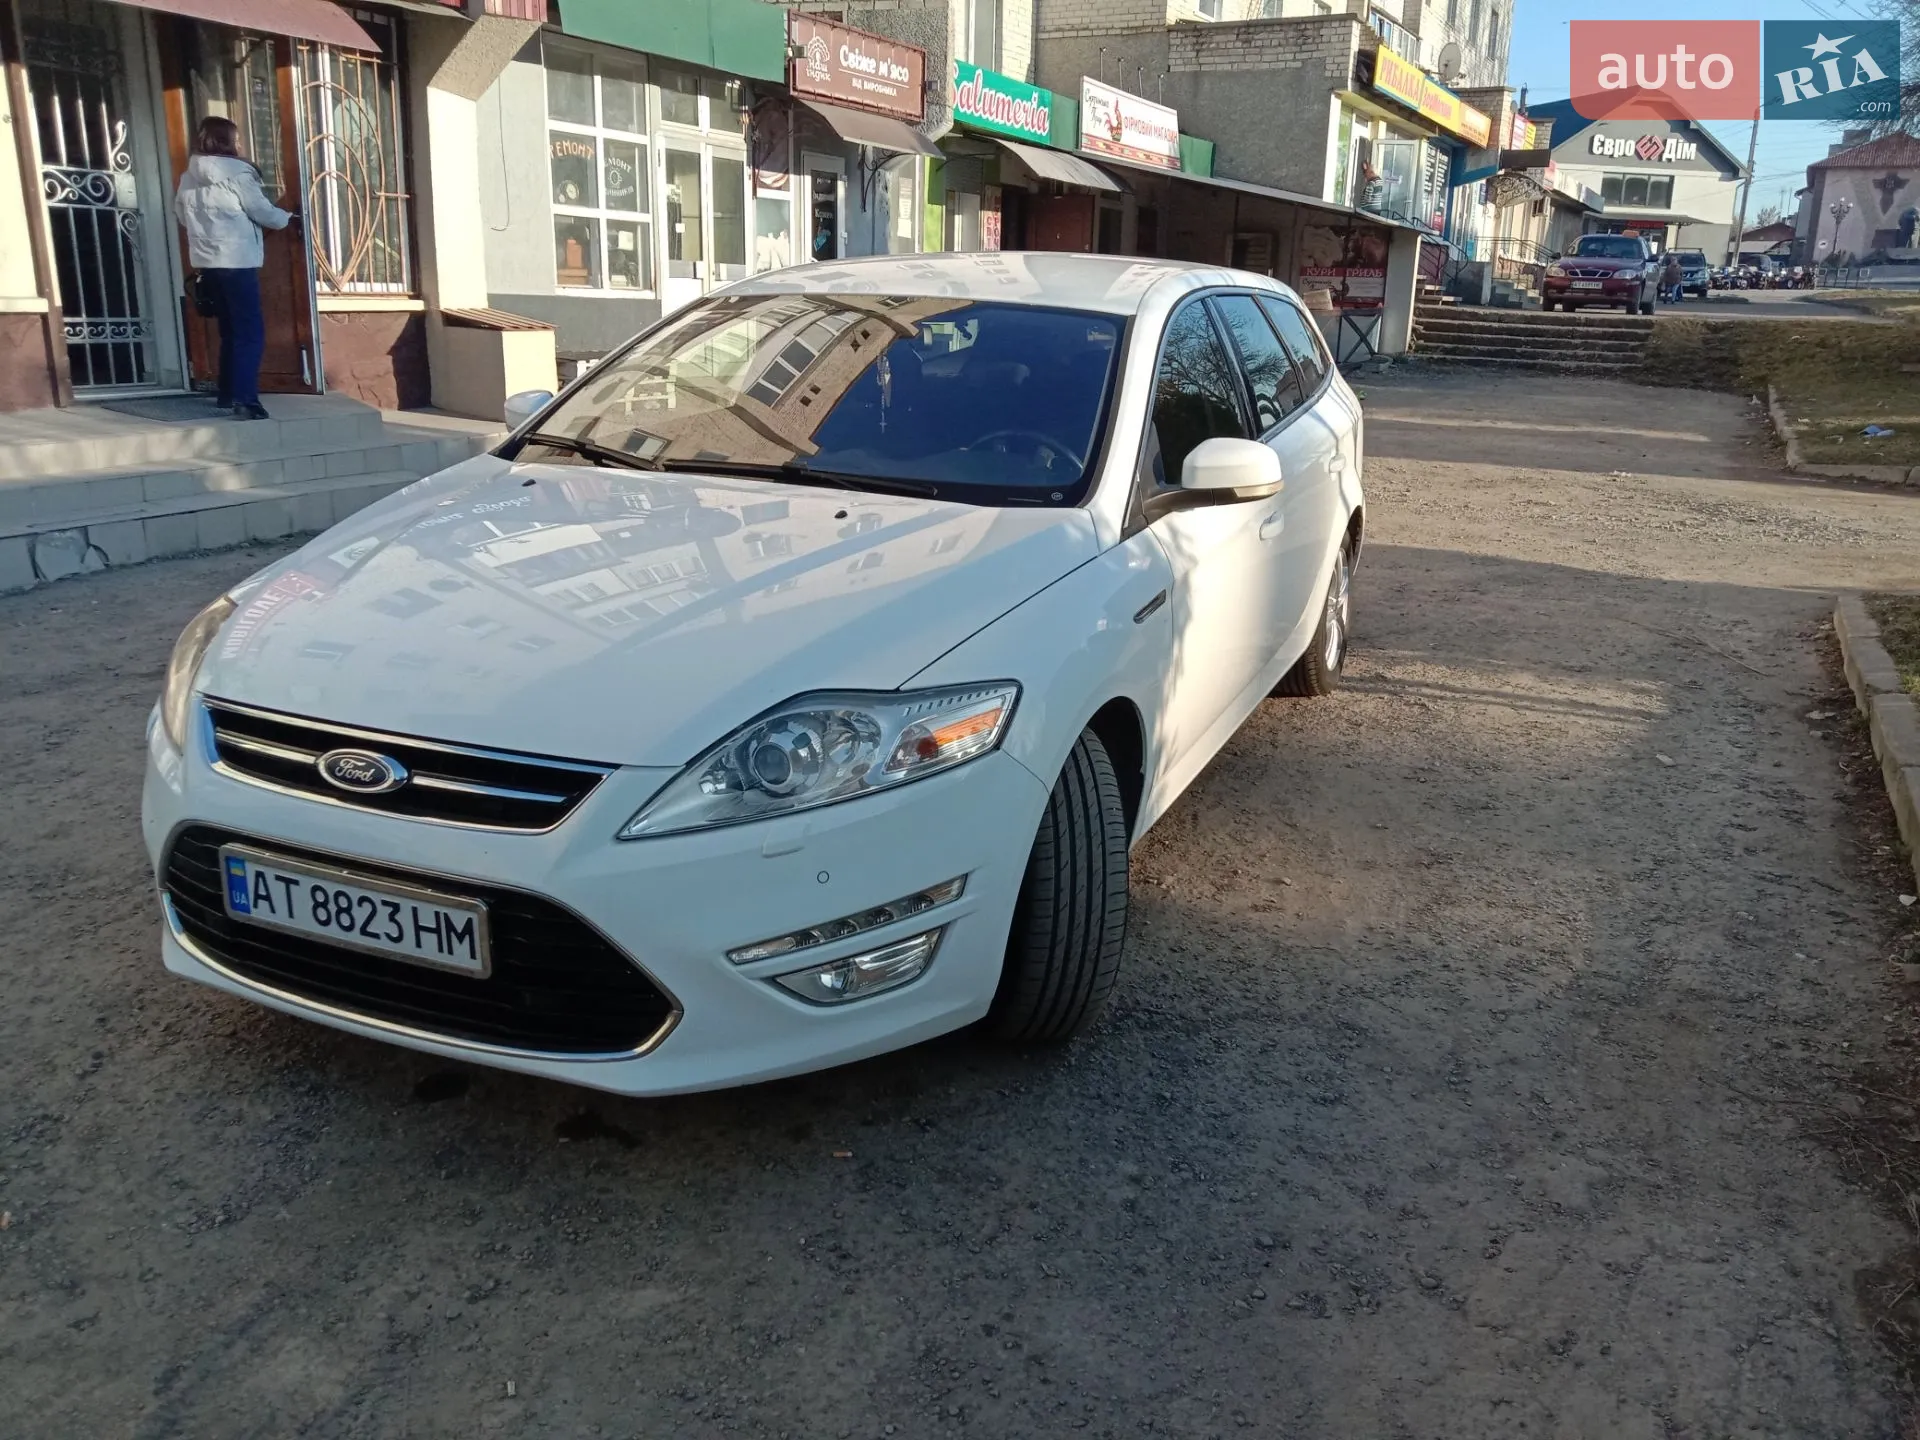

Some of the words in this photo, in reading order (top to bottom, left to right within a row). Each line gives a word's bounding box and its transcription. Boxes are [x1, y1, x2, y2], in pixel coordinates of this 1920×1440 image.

[839, 45, 877, 74] Свіже
[878, 57, 909, 83] м'ясо
[1592, 134, 1636, 158] Євро
[1662, 137, 1697, 162] Дім
[1306, 267, 1336, 276] КУРИ
[1346, 267, 1383, 277] ГРИЛЬ
[334, 758, 376, 784] Ford
[232, 890, 248, 906] UA
[252, 870, 301, 920] AT
[311, 883, 405, 944] 8823
[412, 905, 477, 961] HM
